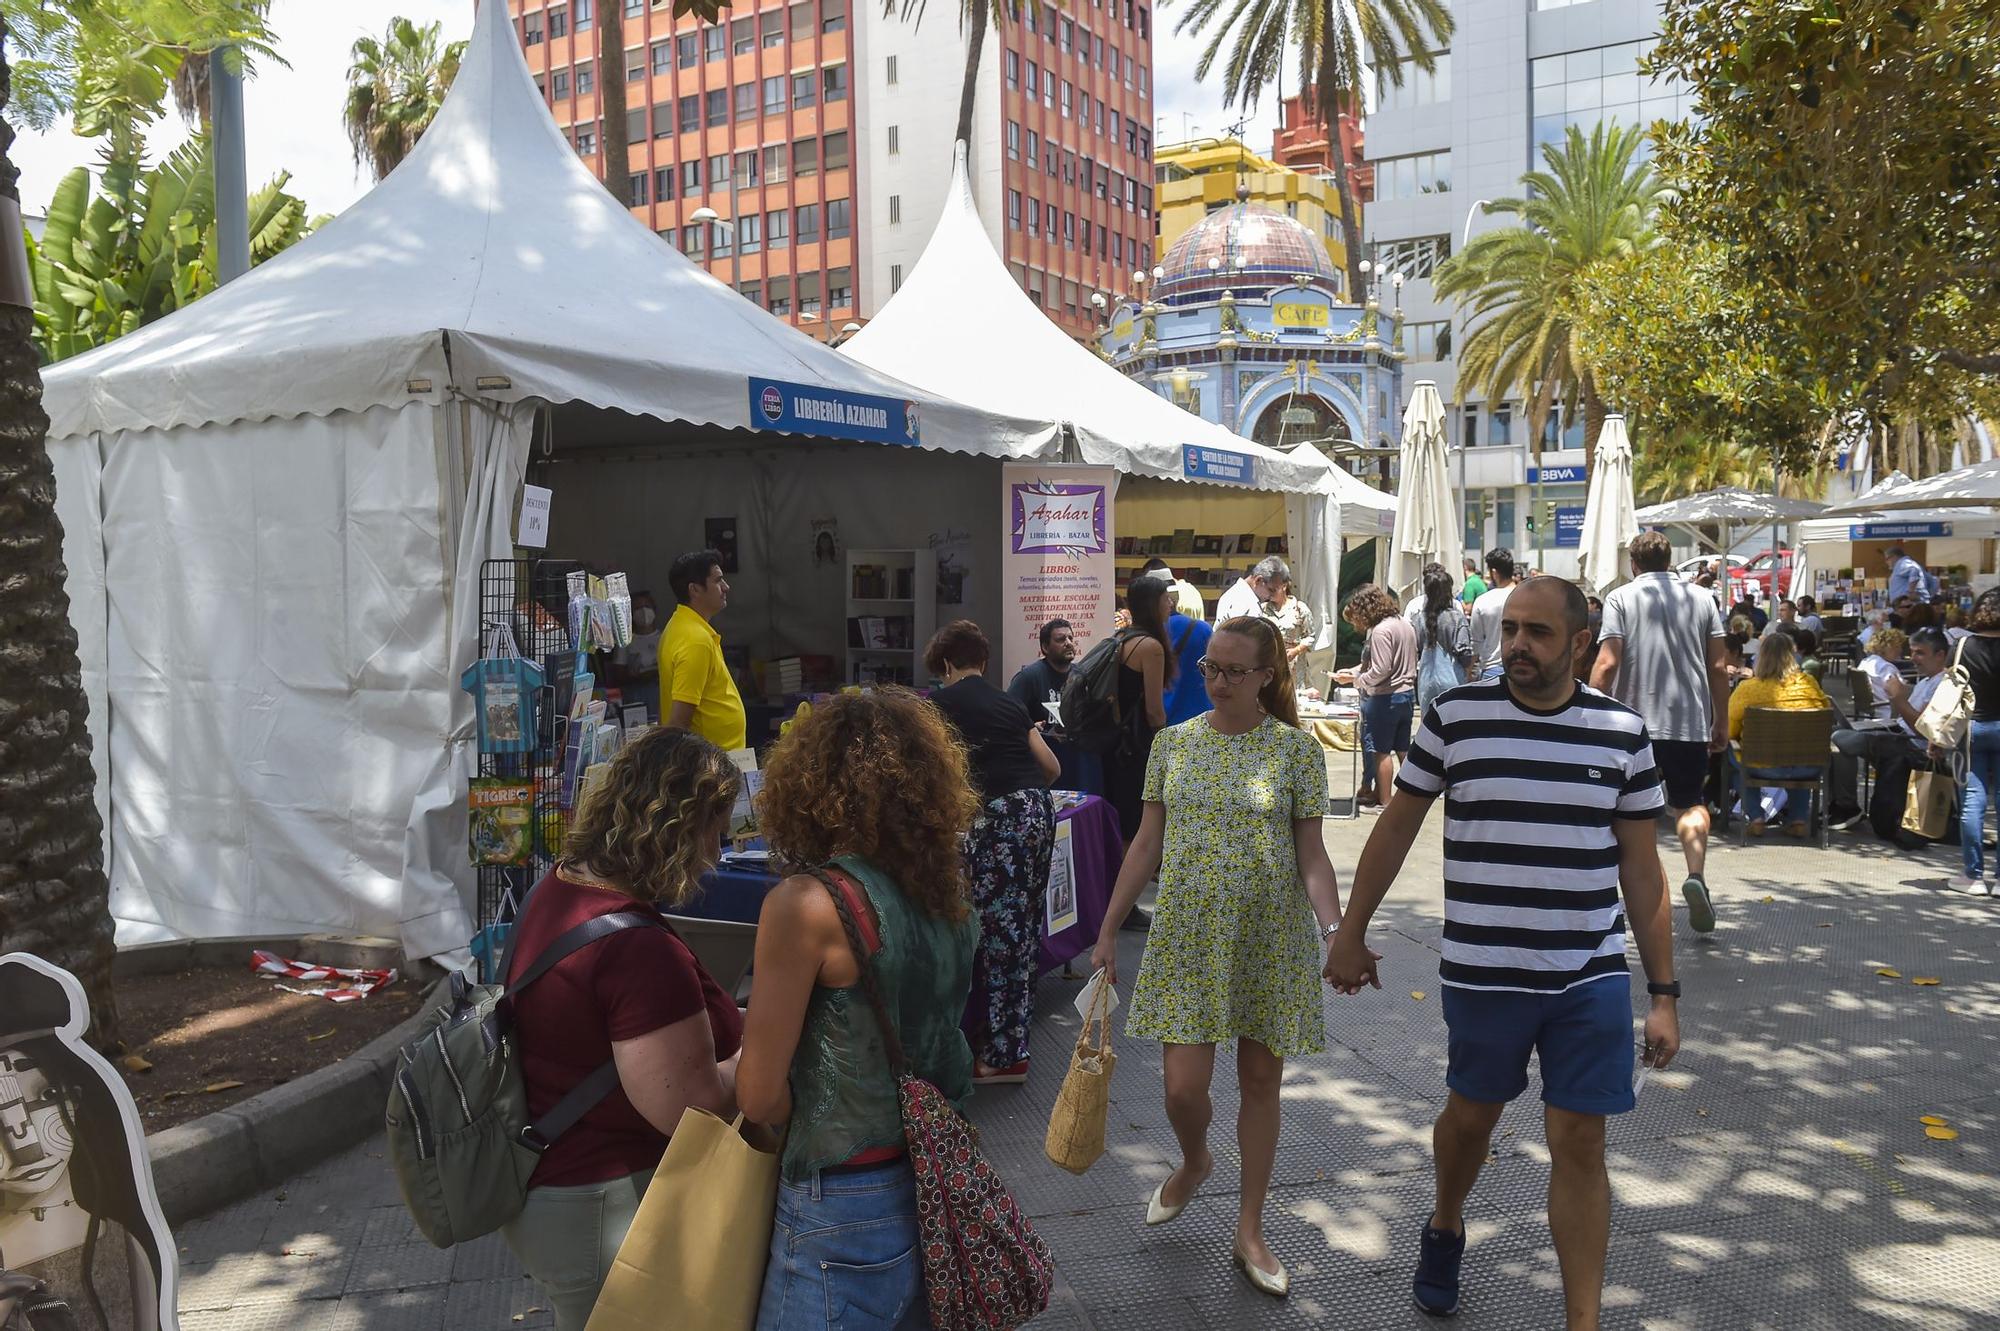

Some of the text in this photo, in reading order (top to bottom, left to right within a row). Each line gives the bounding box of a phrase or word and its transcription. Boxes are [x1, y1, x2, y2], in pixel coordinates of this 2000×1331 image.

[764, 404, 781, 413] LIBRO
[794, 397, 888, 429] LIBRERÍA AZAHAR
[1207, 464, 1225, 476] POPULAR
[1541, 468, 1574, 481] BBVA
[1029, 503, 1090, 526] Azahar
[1040, 566, 1080, 574] LIBROS:
[1019, 595, 1061, 603] MATERIAL
[1023, 603, 1097, 612] ENCUADERNACIÓN
[1025, 613, 1064, 621] SERVICIO
